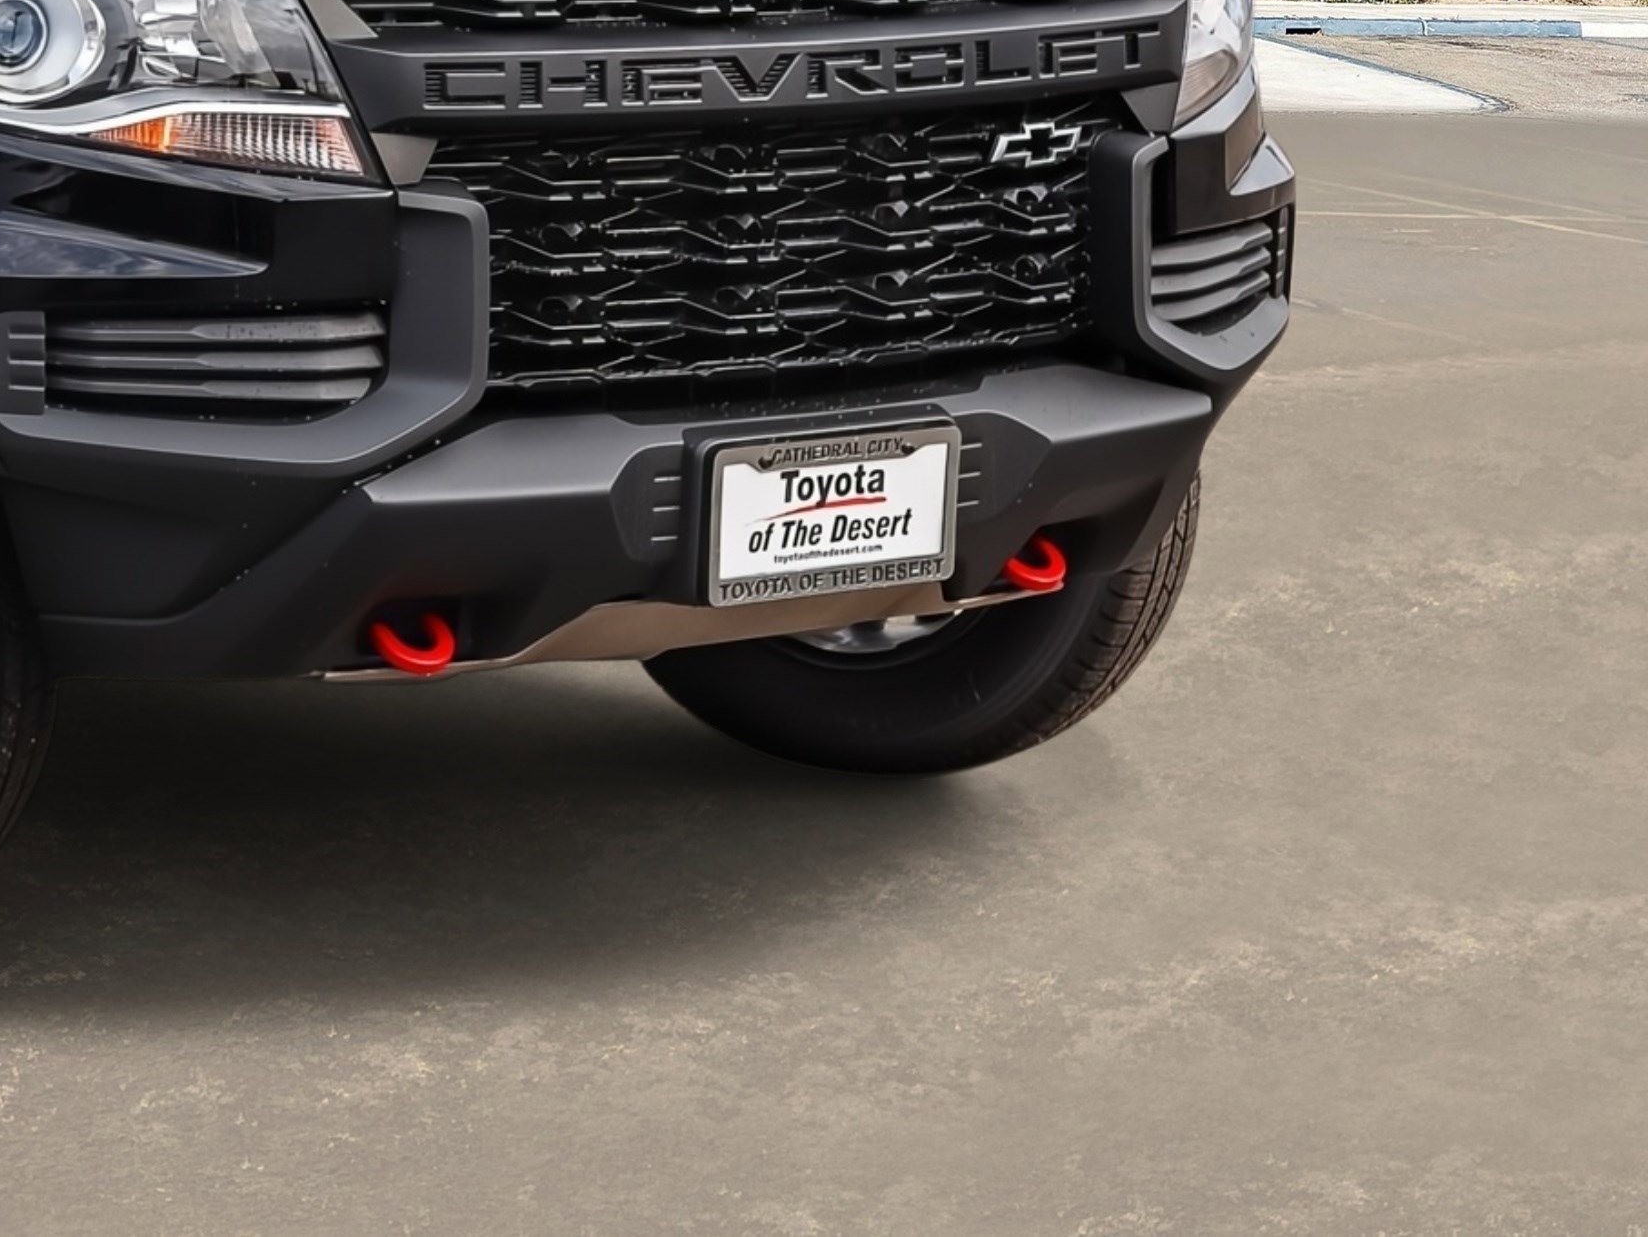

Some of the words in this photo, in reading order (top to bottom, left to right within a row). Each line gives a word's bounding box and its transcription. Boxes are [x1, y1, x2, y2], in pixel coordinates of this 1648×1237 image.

[422, 24, 1161, 110] CHEVROLET
[772, 442, 862, 463] CATHEDRAL
[866, 437, 905, 456] CITY
[780, 464, 886, 507] Toyota
[748, 522, 776, 554] of
[781, 519, 822, 549] The
[830, 507, 912, 544] Desert
[773, 543, 883, 565] toyotaofthedesert.com
[719, 577, 793, 601] TOYOTA
[798, 572, 826, 591] OF
[831, 568, 867, 587] THE
[871, 558, 946, 582] DESERT
